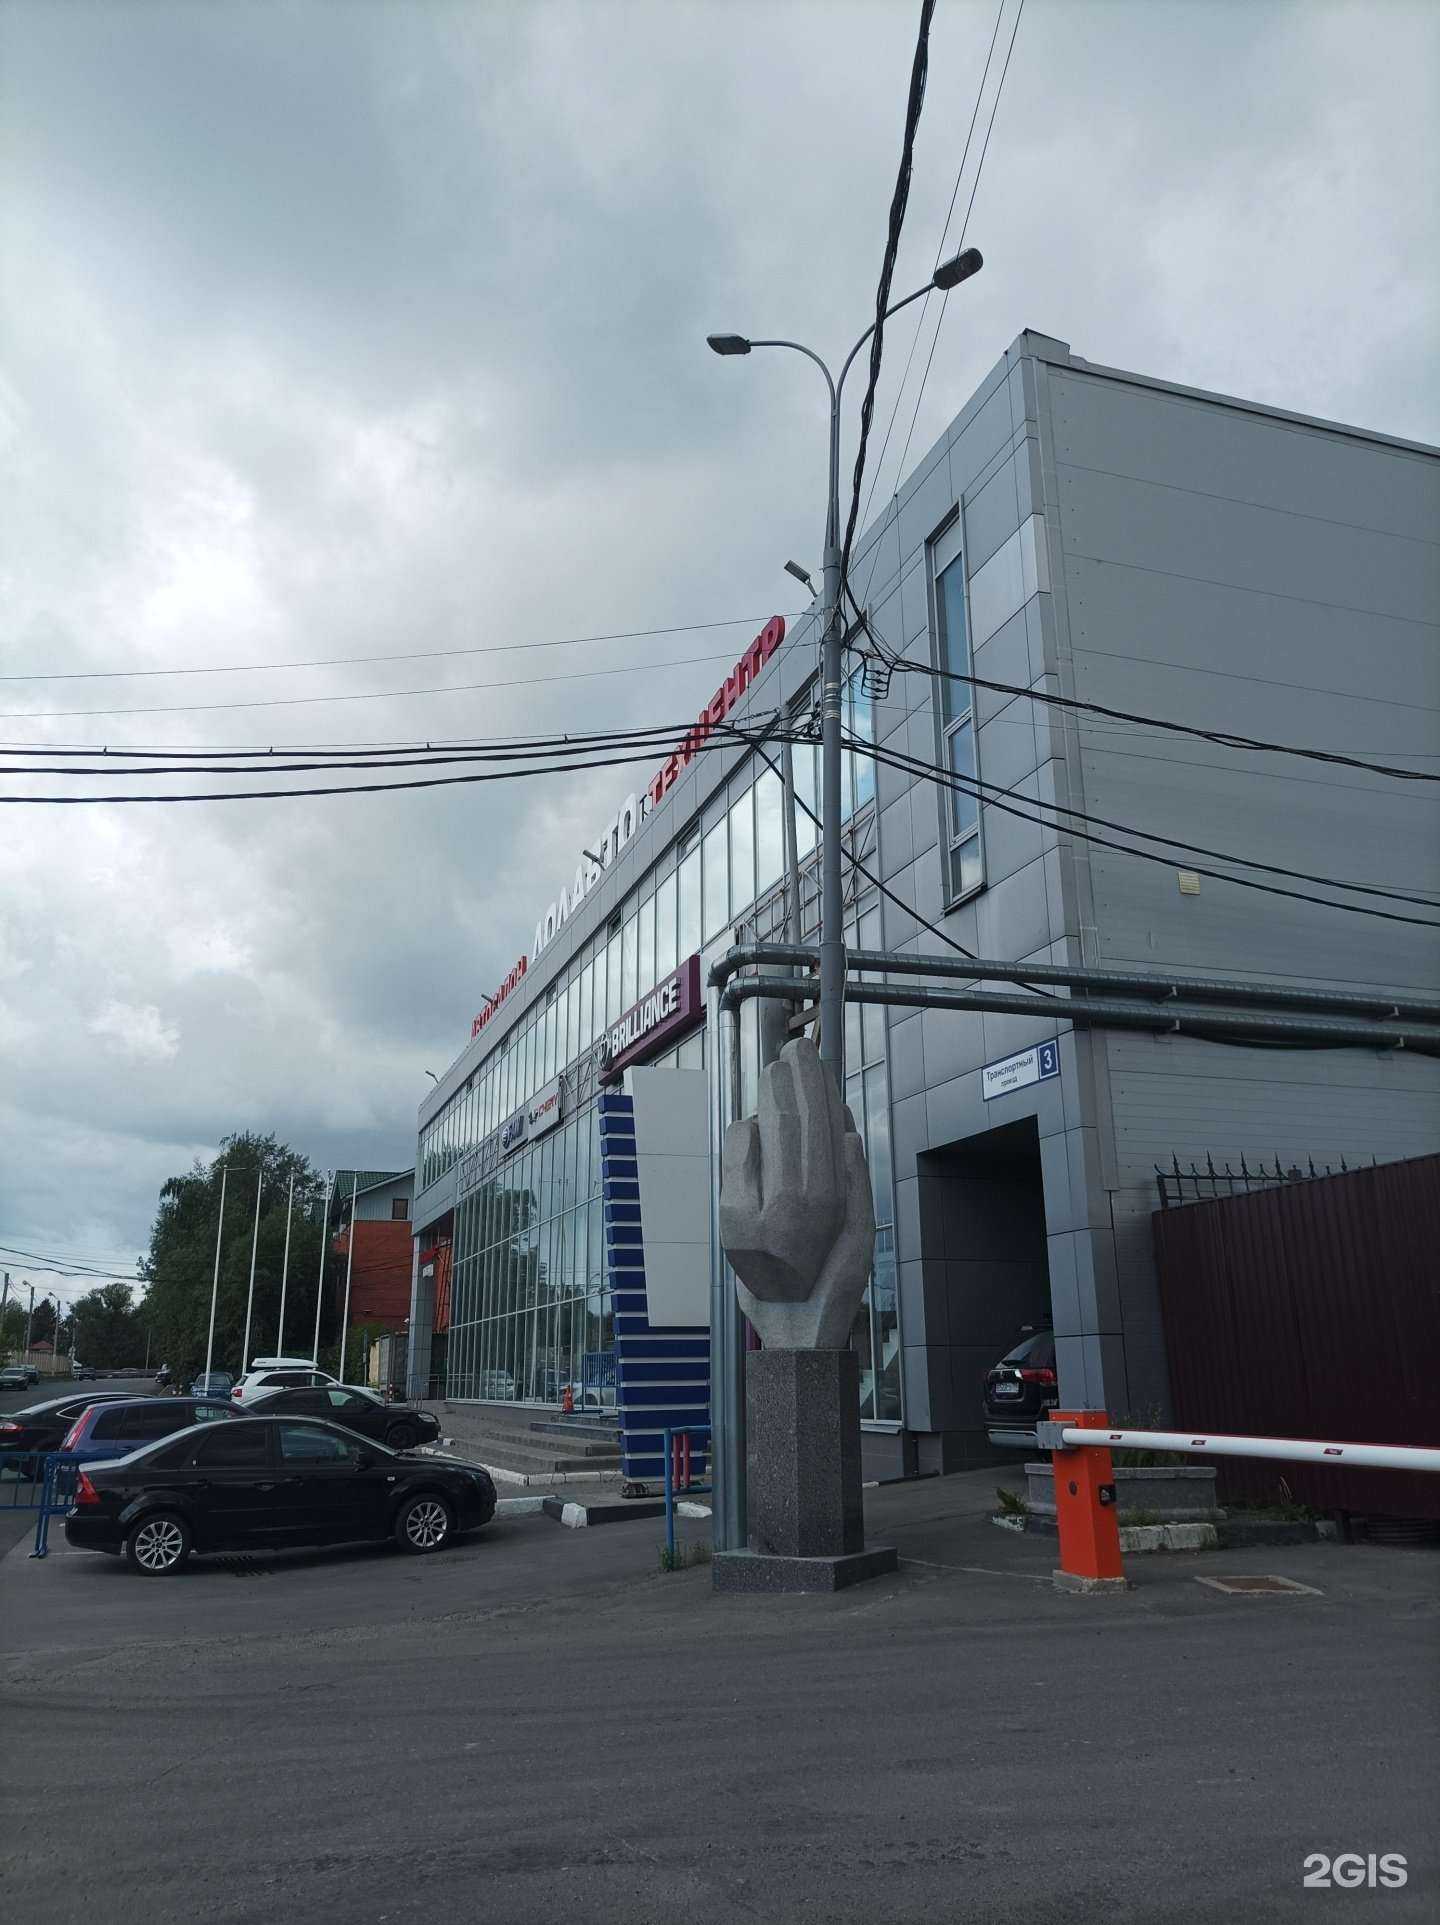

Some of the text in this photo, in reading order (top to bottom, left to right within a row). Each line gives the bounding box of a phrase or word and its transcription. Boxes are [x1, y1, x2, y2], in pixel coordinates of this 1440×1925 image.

[611, 977, 681, 1058] BRILLIANCE
[986, 1054, 1034, 1081] Транспортный
[1043, 1049, 1053, 1069] 3
